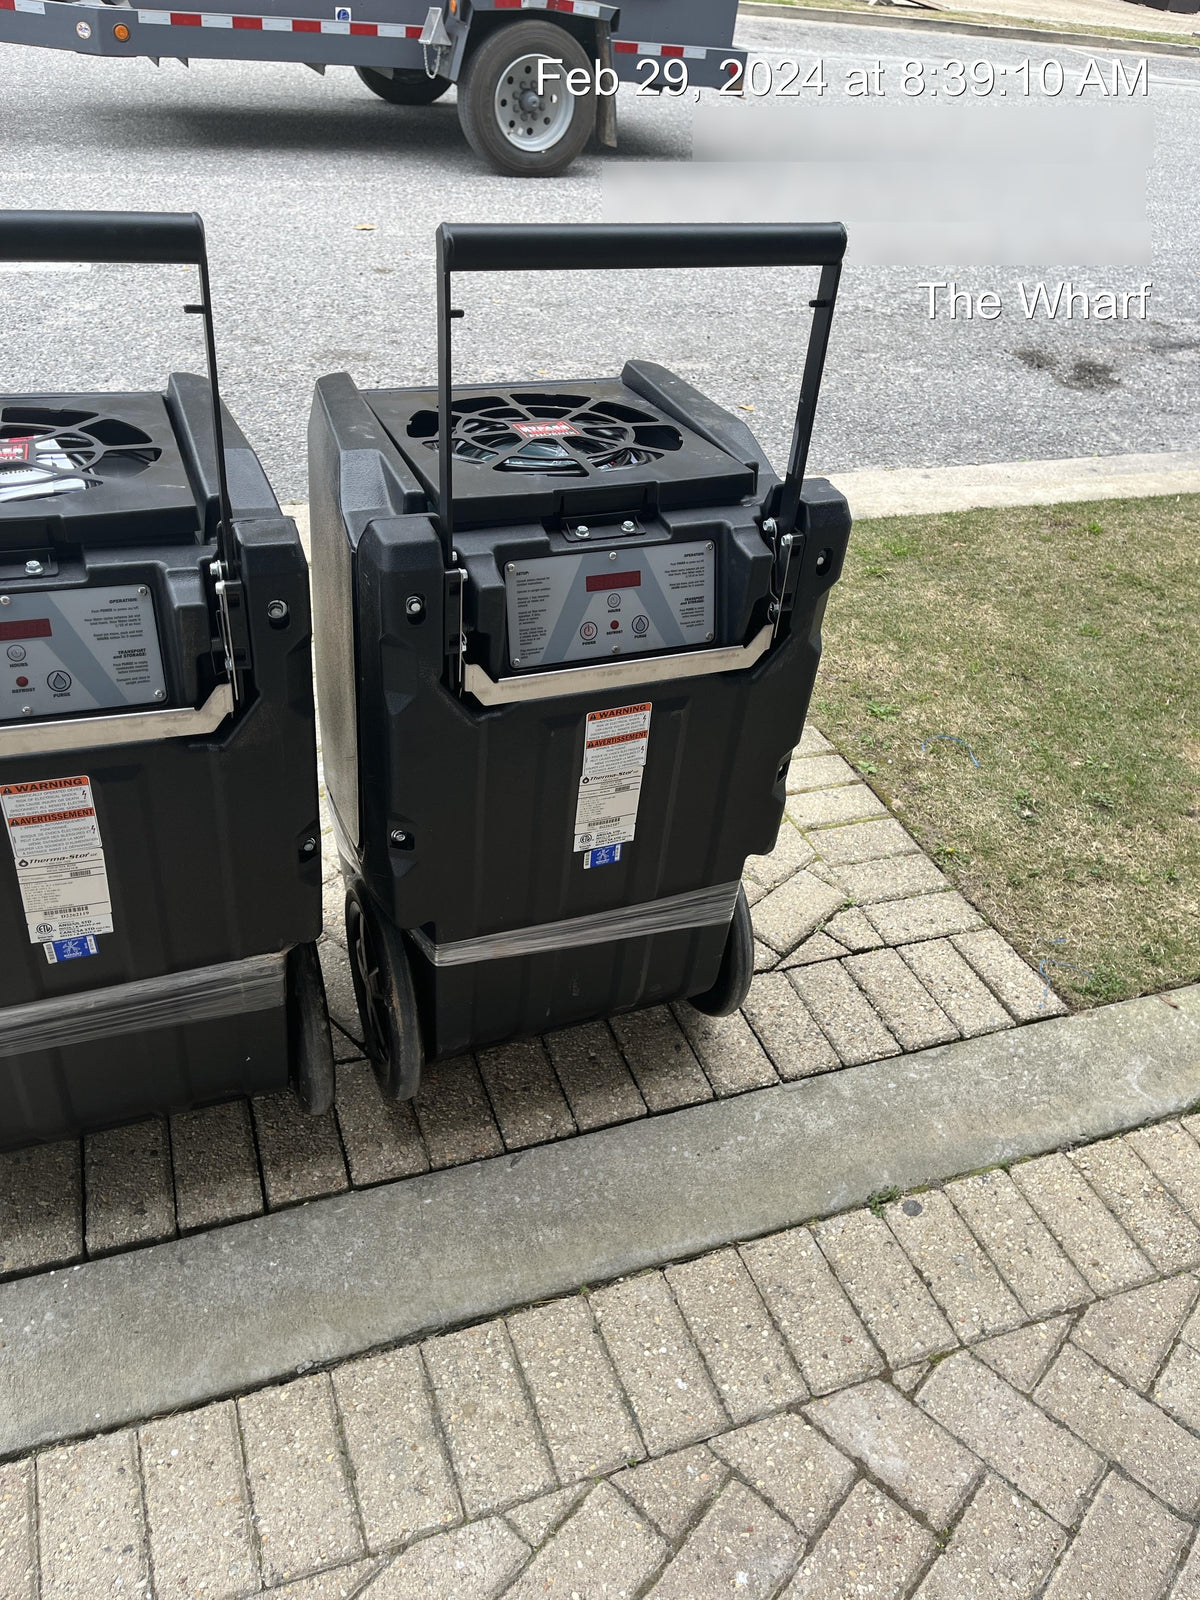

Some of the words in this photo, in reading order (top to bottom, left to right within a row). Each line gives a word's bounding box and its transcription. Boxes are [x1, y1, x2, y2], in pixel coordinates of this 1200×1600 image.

[599, 705, 646, 719] WARNING
[595, 732, 646, 747] AVERTISSEMENT
[16, 779, 82, 792] WARNING
[20, 809, 93, 824] AVERTISSEMENT
